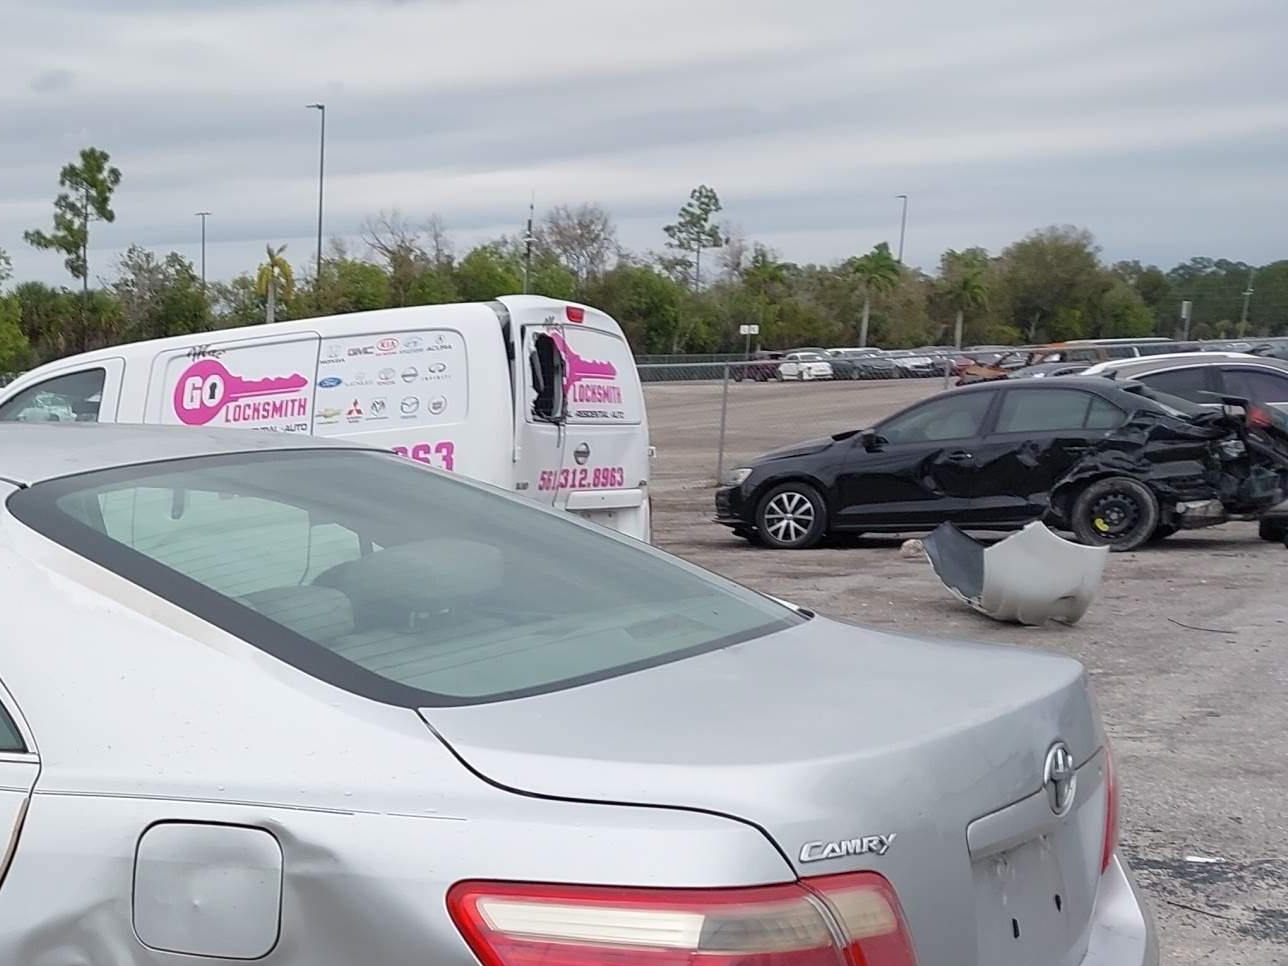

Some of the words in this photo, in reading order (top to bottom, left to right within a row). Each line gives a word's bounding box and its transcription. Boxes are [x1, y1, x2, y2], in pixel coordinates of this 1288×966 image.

[183, 374, 224, 410] GO
[573, 384, 622, 403] LOCKSMITH
[224, 398, 307, 423] LOCKSMITH
[799, 833, 896, 863] CAMRY
